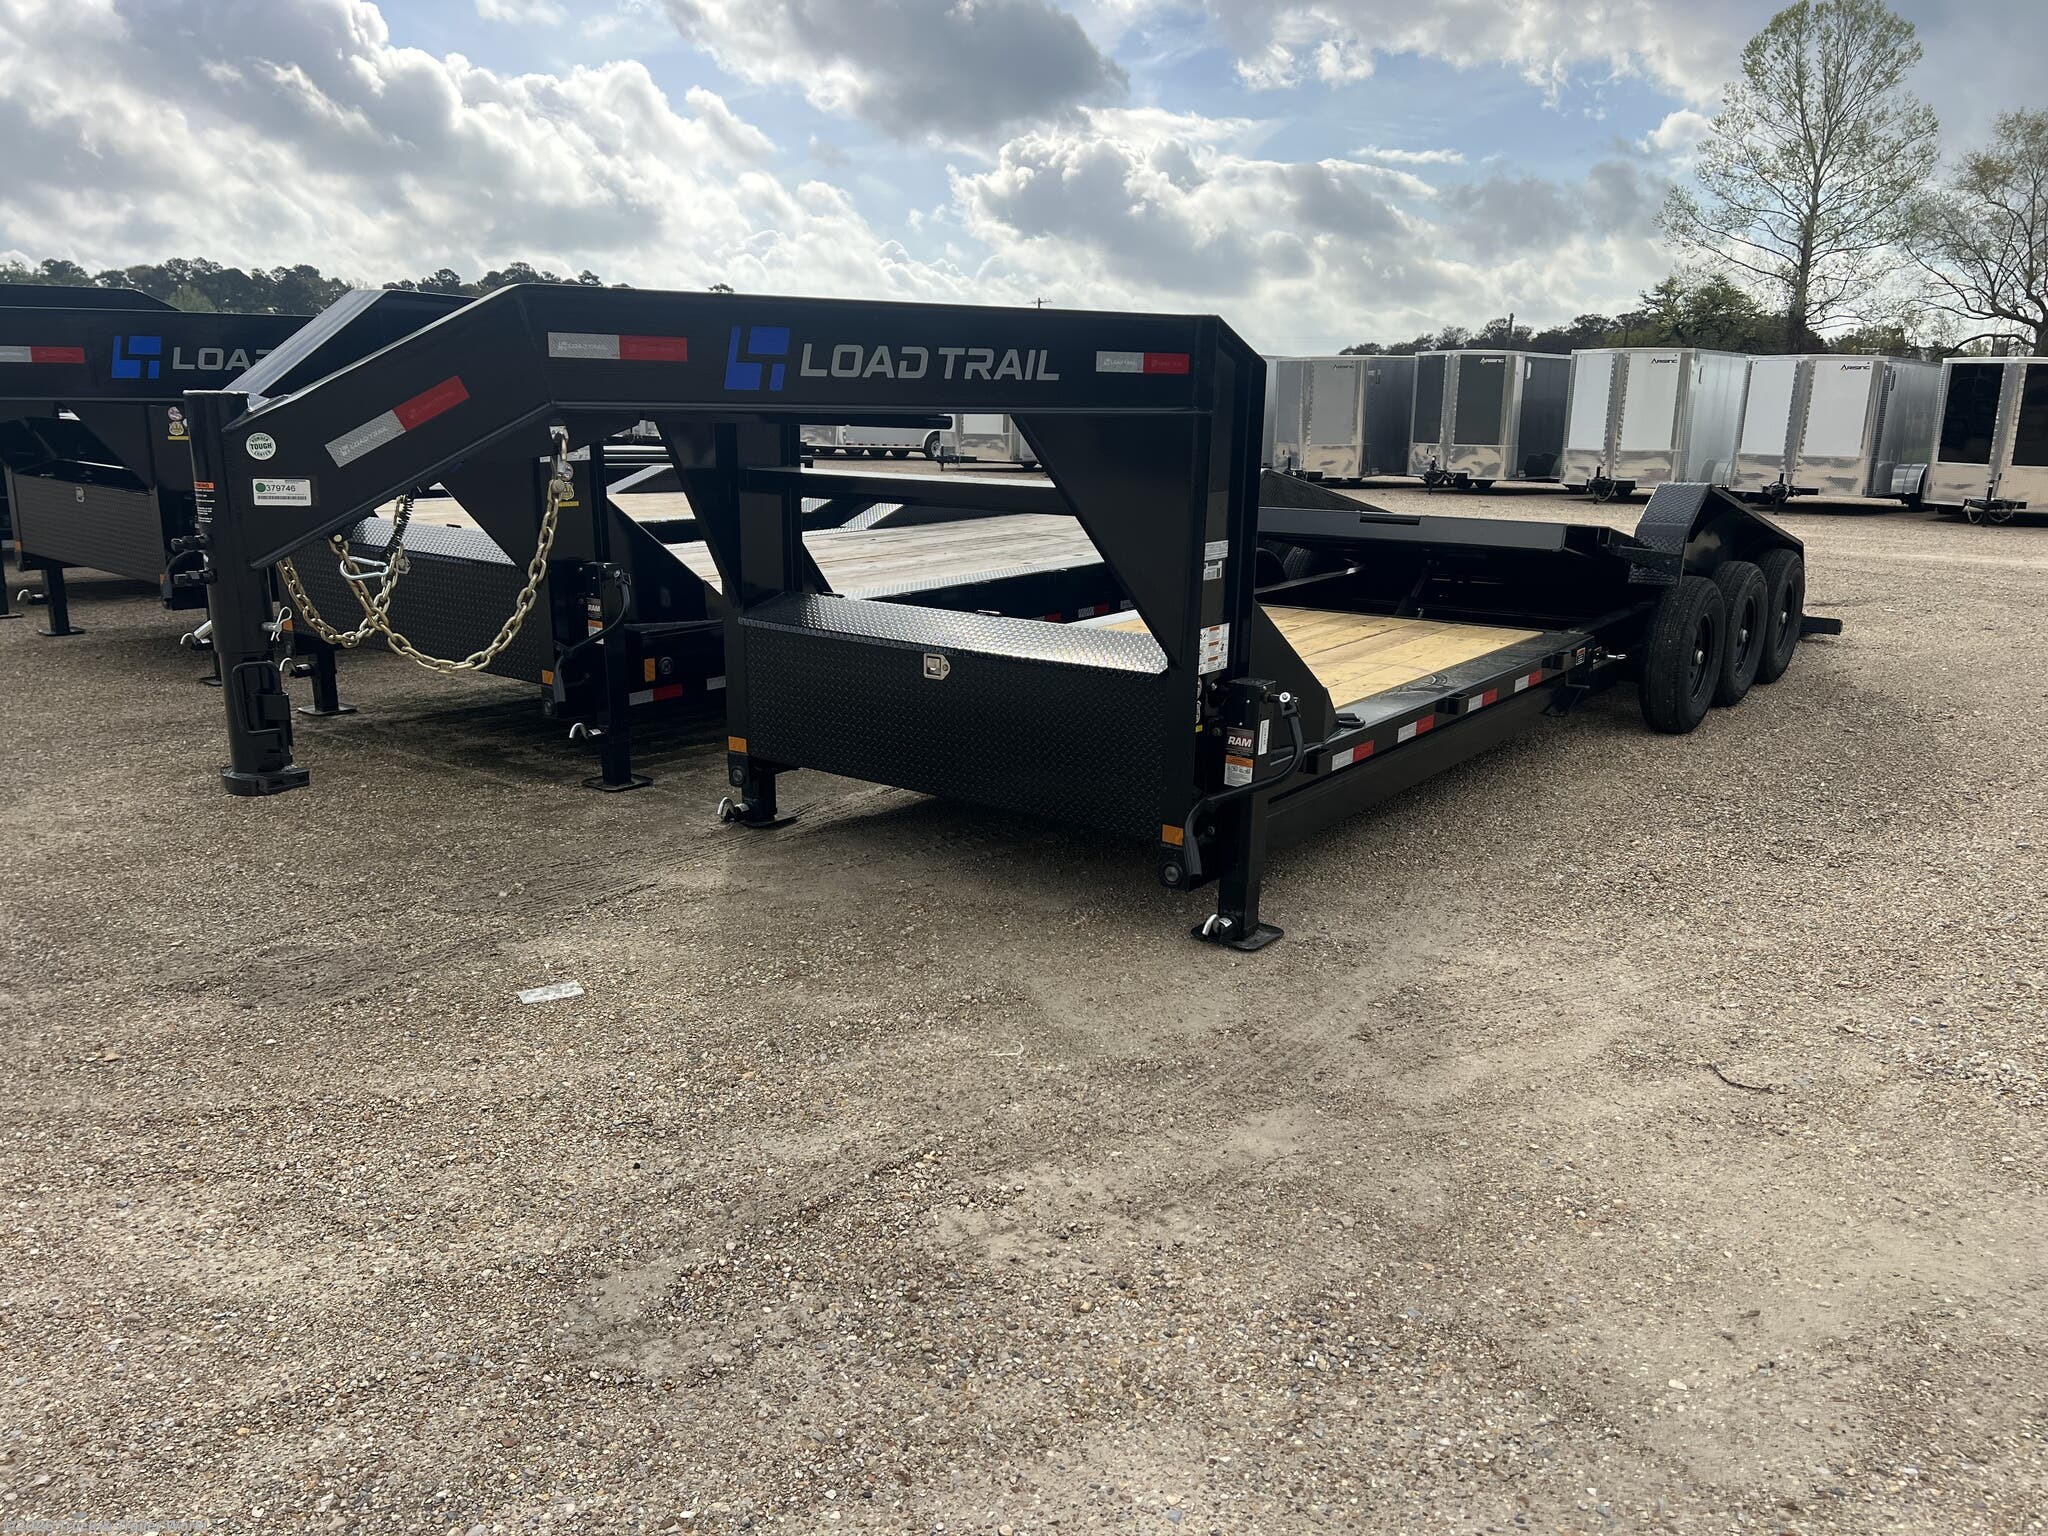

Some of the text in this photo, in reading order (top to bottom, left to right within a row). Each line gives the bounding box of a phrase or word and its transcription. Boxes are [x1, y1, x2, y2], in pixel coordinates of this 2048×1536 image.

[172, 346, 275, 371] LOA
[800, 342, 1060, 381] LOAD TRAIL
[250, 442, 273, 451] TOUGH
[266, 484, 296, 492] 379746
[1227, 736, 1252, 748] RAM
